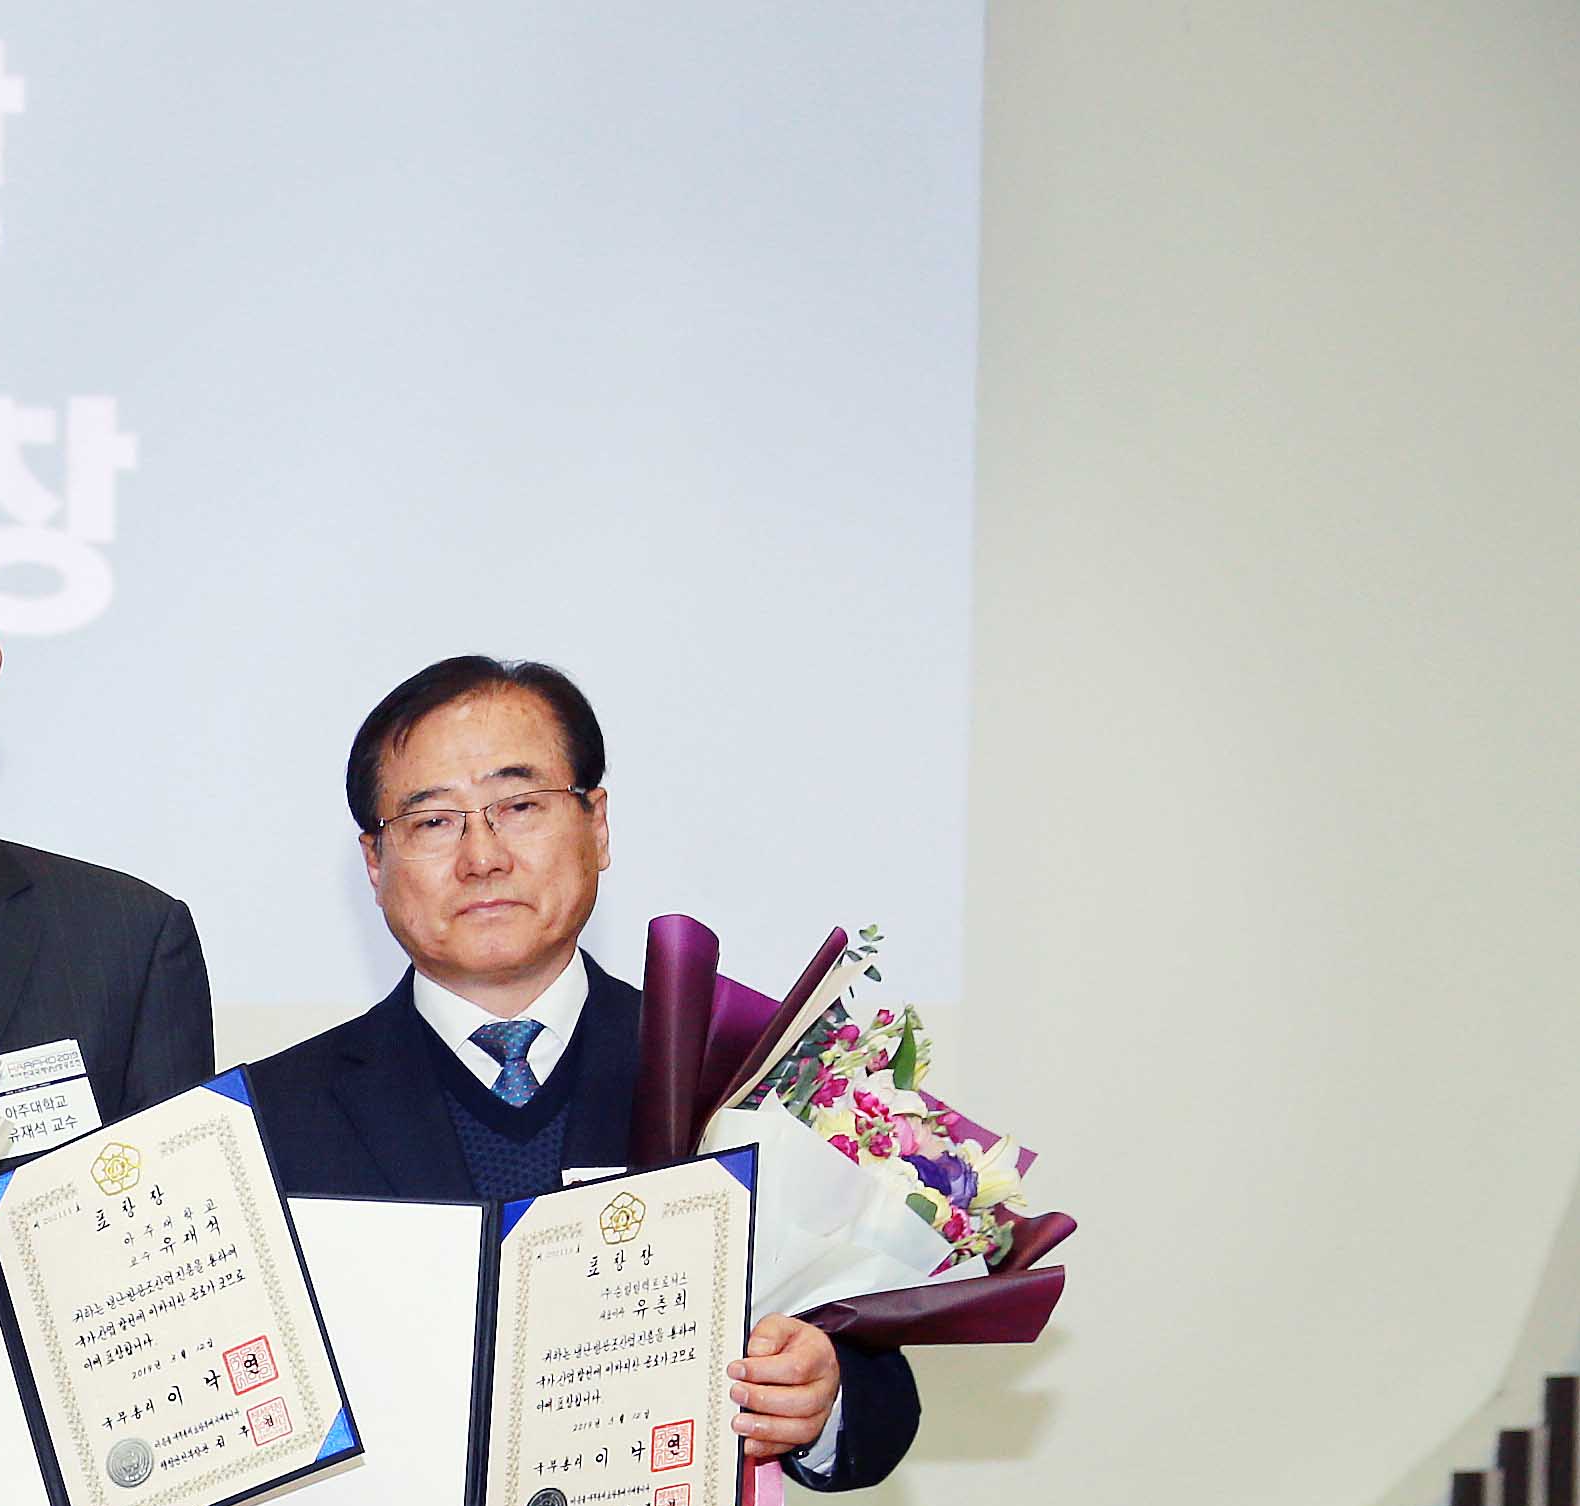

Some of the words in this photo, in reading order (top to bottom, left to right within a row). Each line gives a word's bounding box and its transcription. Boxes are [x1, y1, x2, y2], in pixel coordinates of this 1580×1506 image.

[4, 1095, 69, 1120] 아주대학교
[8, 1121, 48, 1143] 유재석
[51, 1114, 78, 1132] 교수
